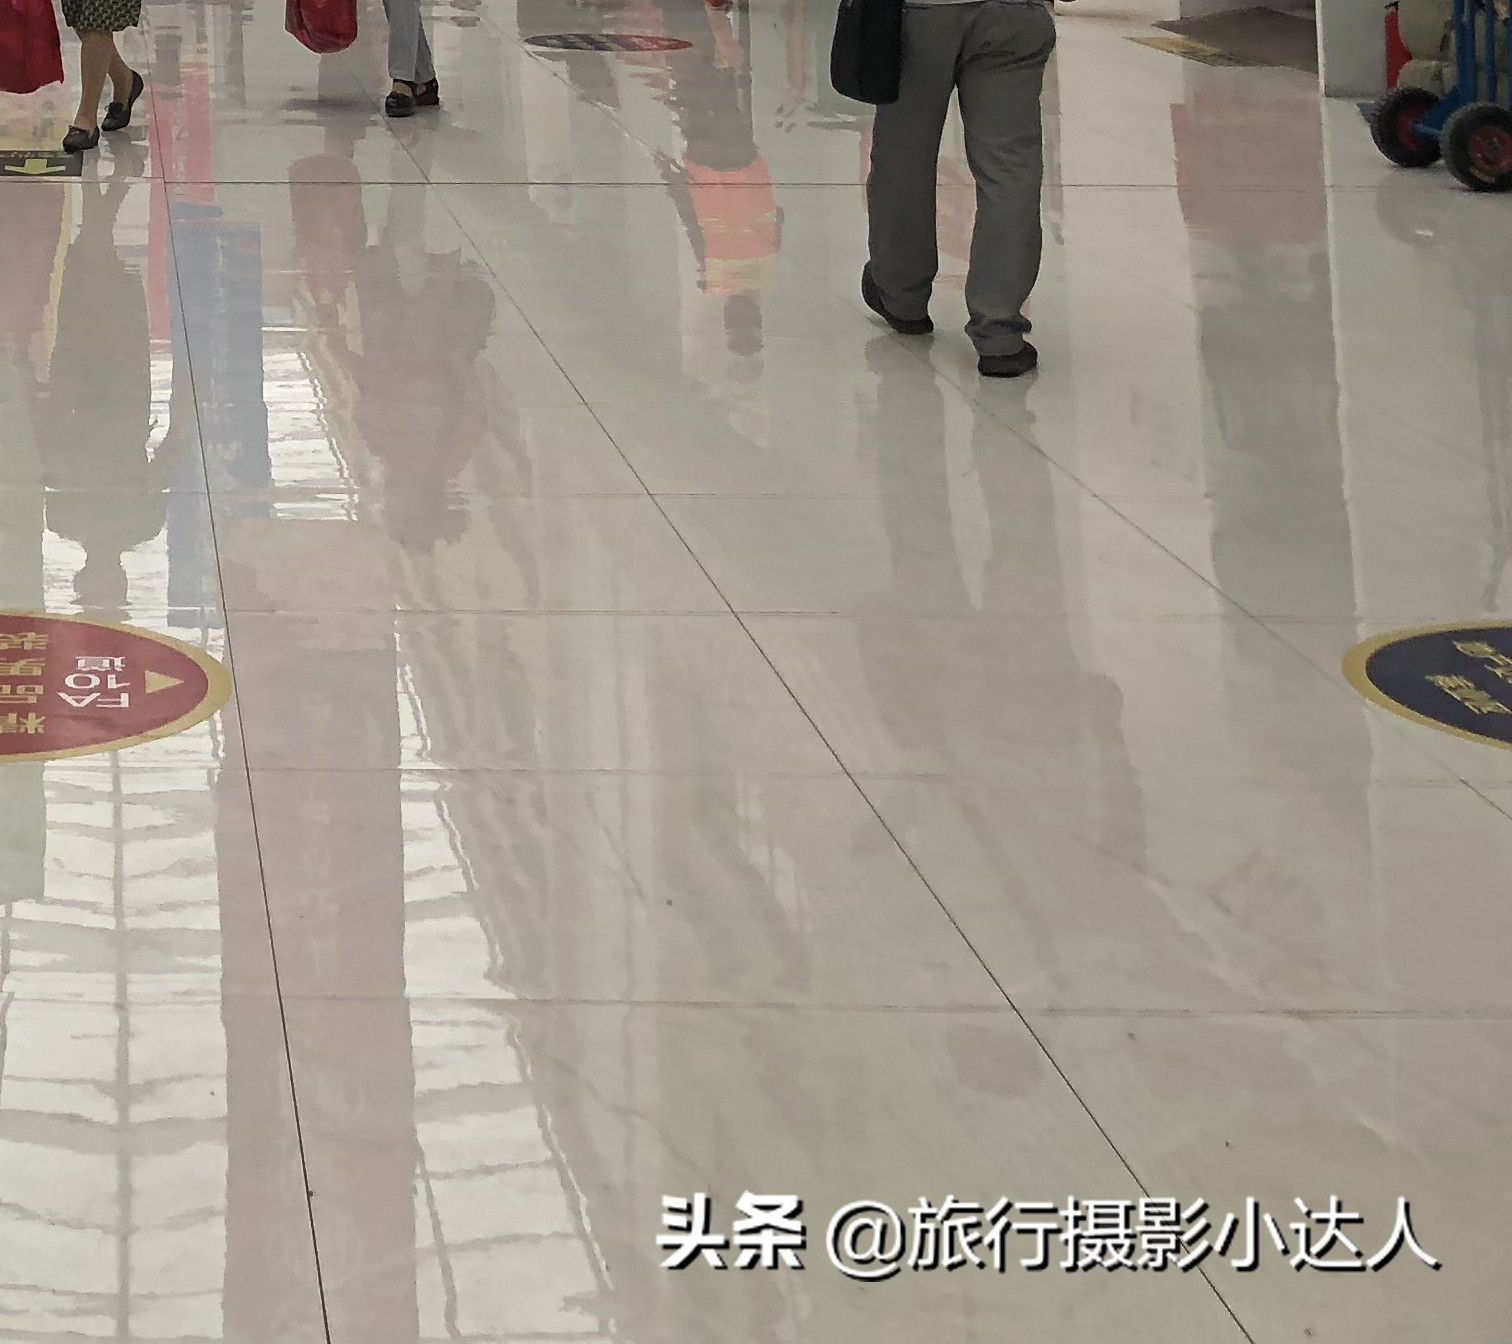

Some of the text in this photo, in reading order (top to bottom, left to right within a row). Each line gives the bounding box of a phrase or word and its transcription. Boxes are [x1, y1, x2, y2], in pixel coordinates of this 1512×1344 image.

[75, 655, 126, 672] 道
[64, 672, 132, 689] 10
[57, 691, 131, 708] FA
